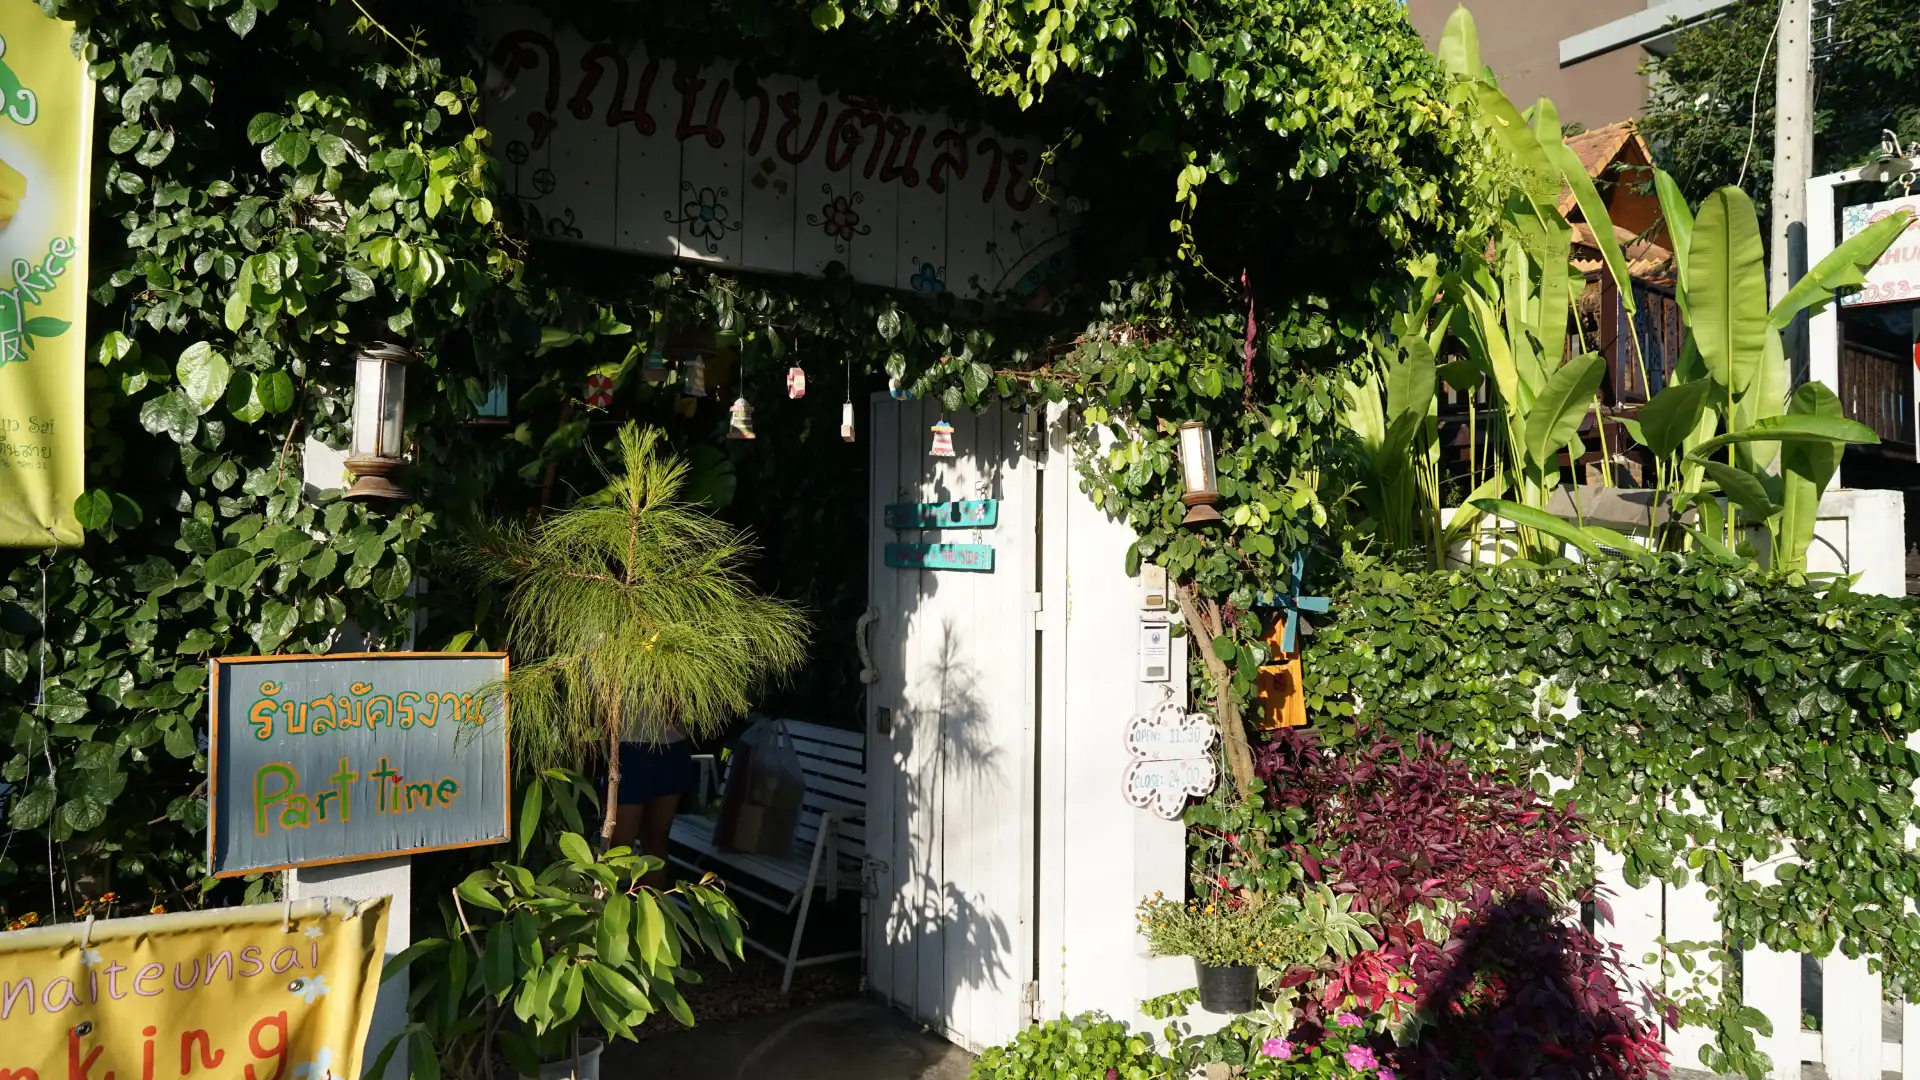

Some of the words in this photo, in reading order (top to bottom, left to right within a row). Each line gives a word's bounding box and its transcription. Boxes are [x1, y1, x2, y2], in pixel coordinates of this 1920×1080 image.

[28, 415, 56, 435] Sai
[249, 681, 486, 741] รับสมัครงาน
[1135, 728, 1161, 742] OPEN:
[1169, 727, 1201, 743] 11.30
[254, 757, 358, 836] Part
[369, 756, 460, 814] time
[1134, 772, 1164, 789] CLOSE:
[0, 1010, 288, 1080] king
